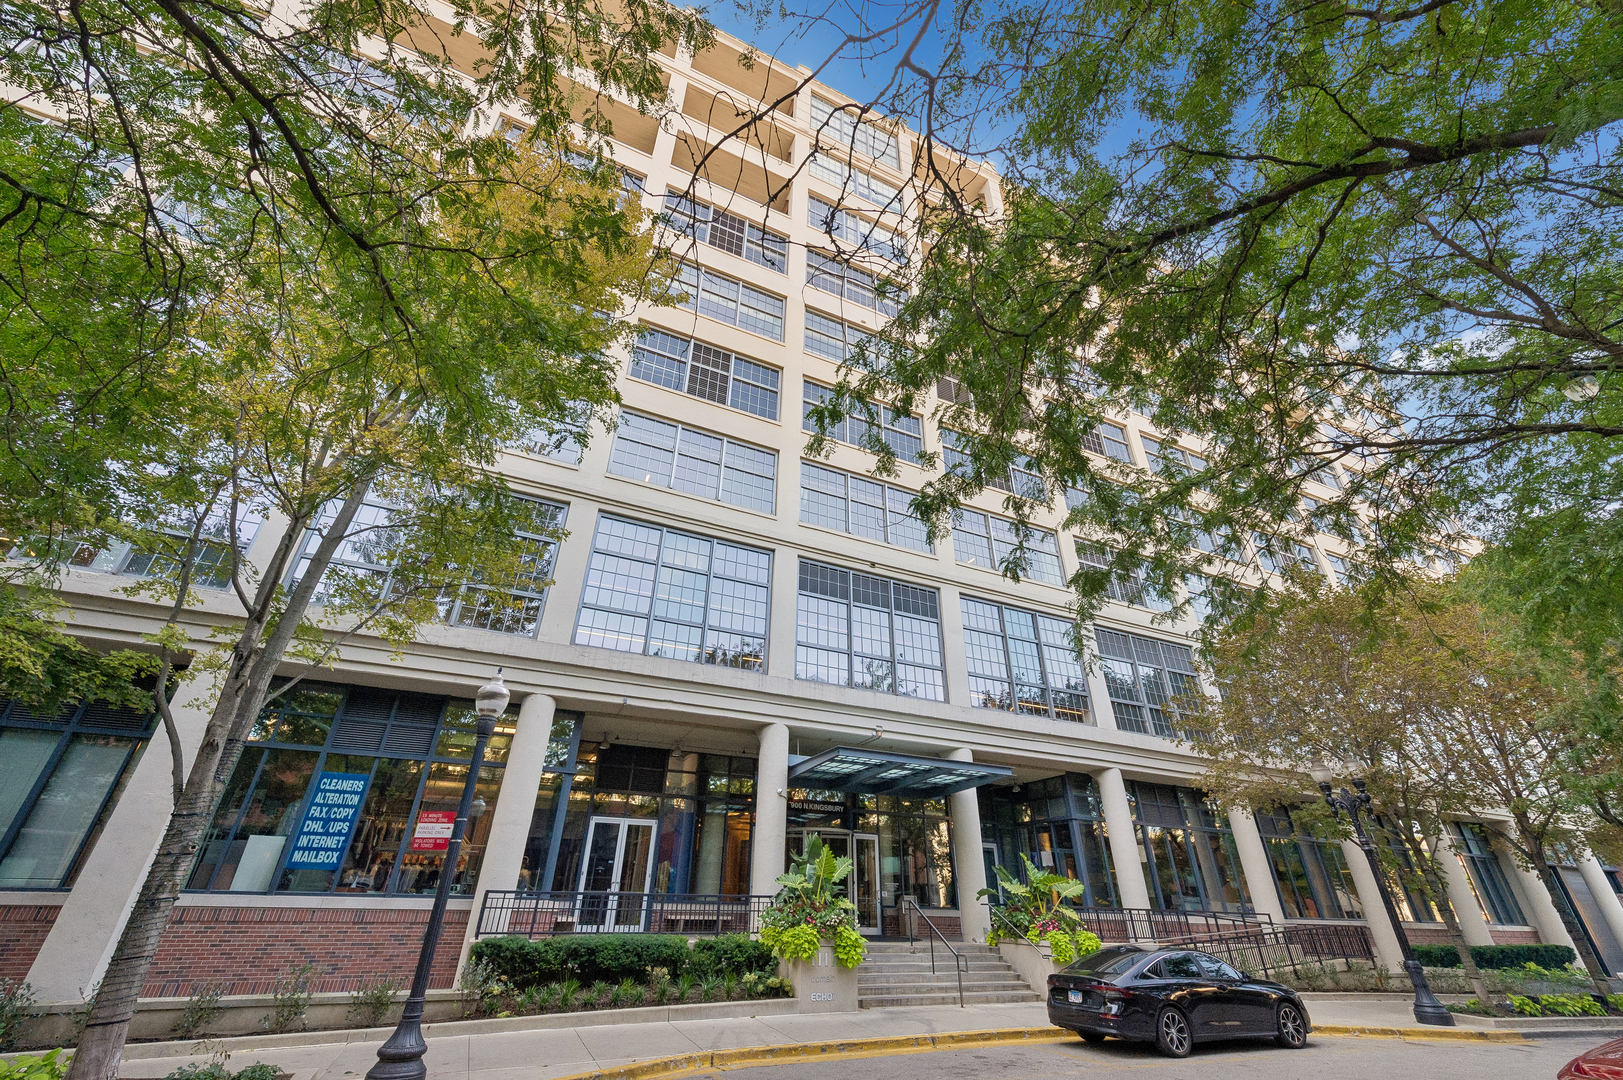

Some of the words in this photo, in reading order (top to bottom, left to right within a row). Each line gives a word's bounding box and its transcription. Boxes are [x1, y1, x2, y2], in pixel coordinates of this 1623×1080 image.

[320, 778, 364, 792] CLEANERS
[314, 792, 361, 806] ALTERATION
[308, 806, 355, 819] FAX/COPY
[303, 820, 350, 833] DHL/UPS
[297, 835, 345, 849] INTERNET
[292, 850, 340, 864] MAILBOX
[810, 992, 833, 1002] ECHO
